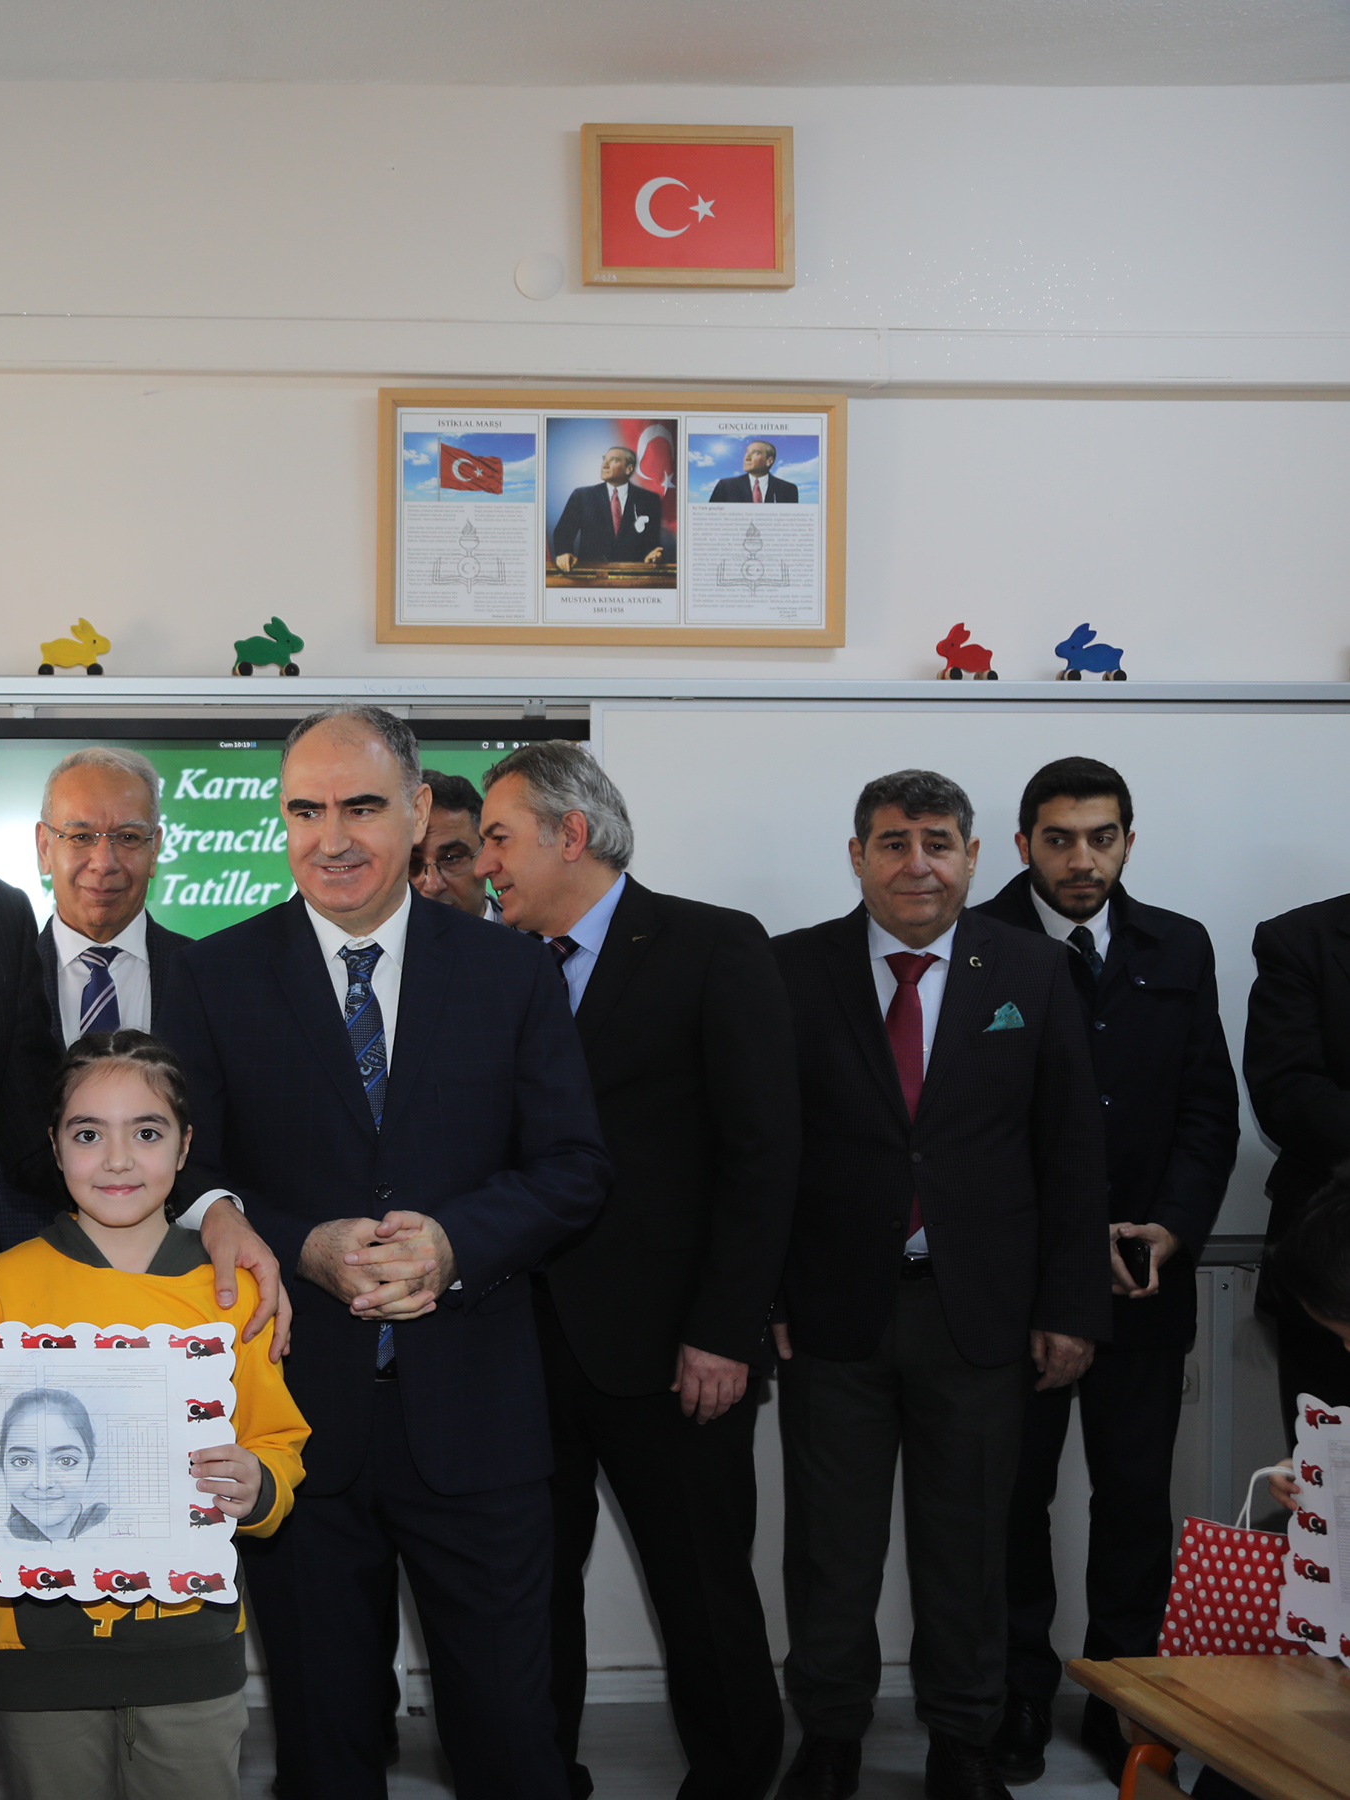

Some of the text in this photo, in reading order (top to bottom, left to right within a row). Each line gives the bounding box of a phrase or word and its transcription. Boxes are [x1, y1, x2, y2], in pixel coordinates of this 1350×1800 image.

[560, 595, 663, 604] MUSTAFA KEMAL ATATÜRK
[174, 768, 278, 800] Karne
[161, 870, 282, 906] Tatiller
